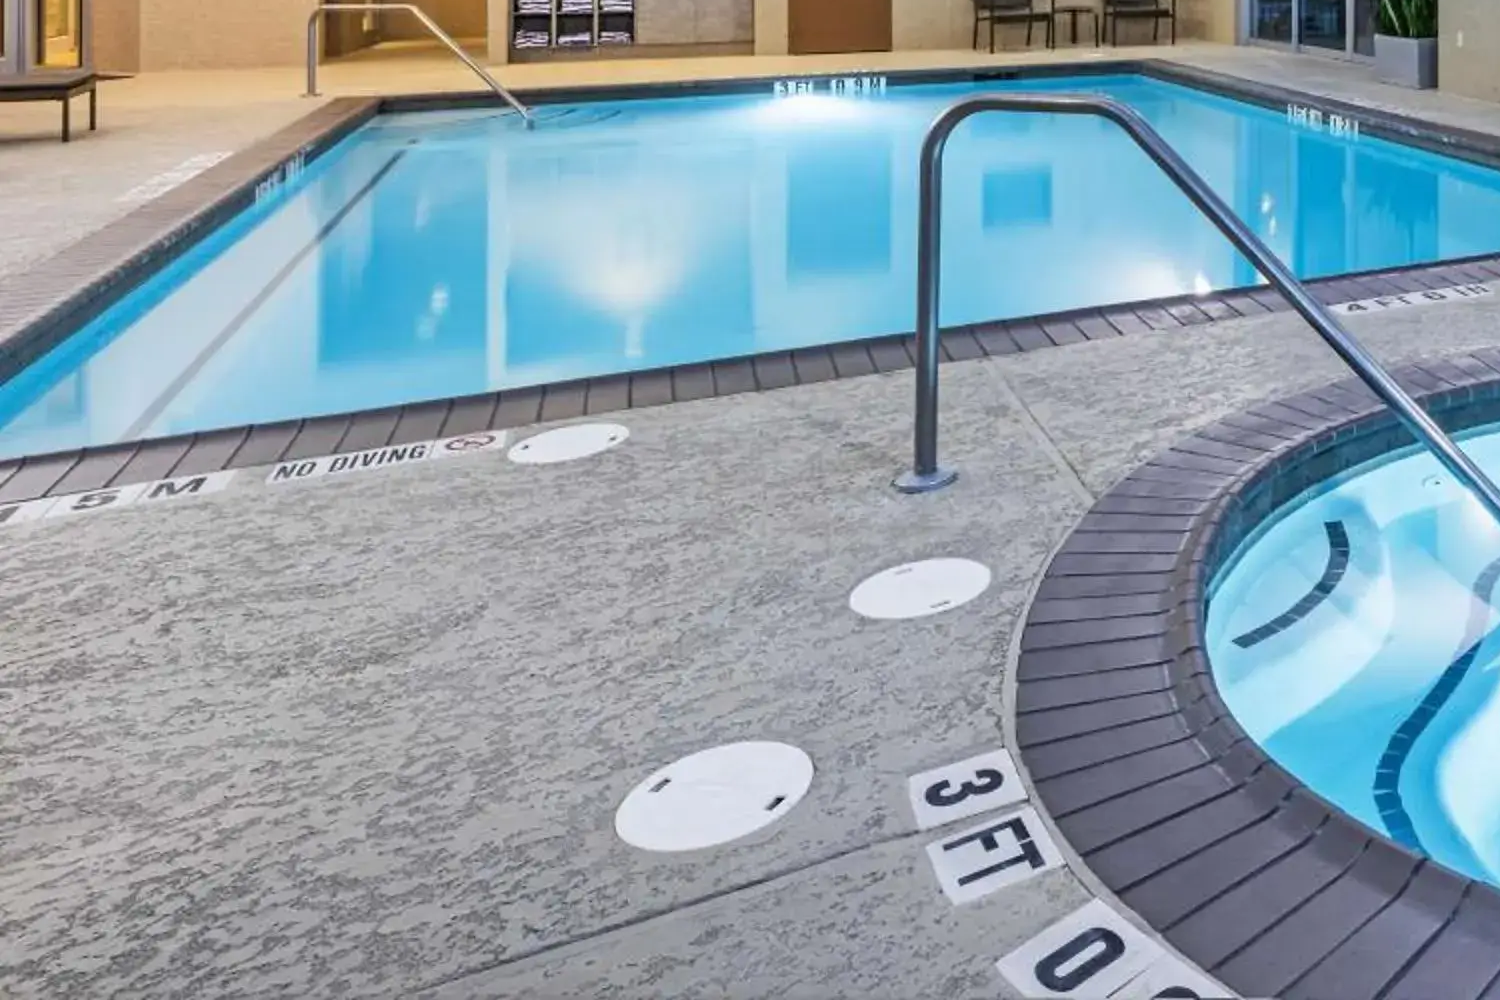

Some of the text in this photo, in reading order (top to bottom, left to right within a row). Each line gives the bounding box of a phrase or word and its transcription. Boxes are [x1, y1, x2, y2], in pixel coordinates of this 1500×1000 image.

[148, 476, 208, 499] M
[273, 445, 427, 481] NO DIVING
[924, 768, 1046, 887] 3 FT
[1034, 927, 1126, 993] 0
